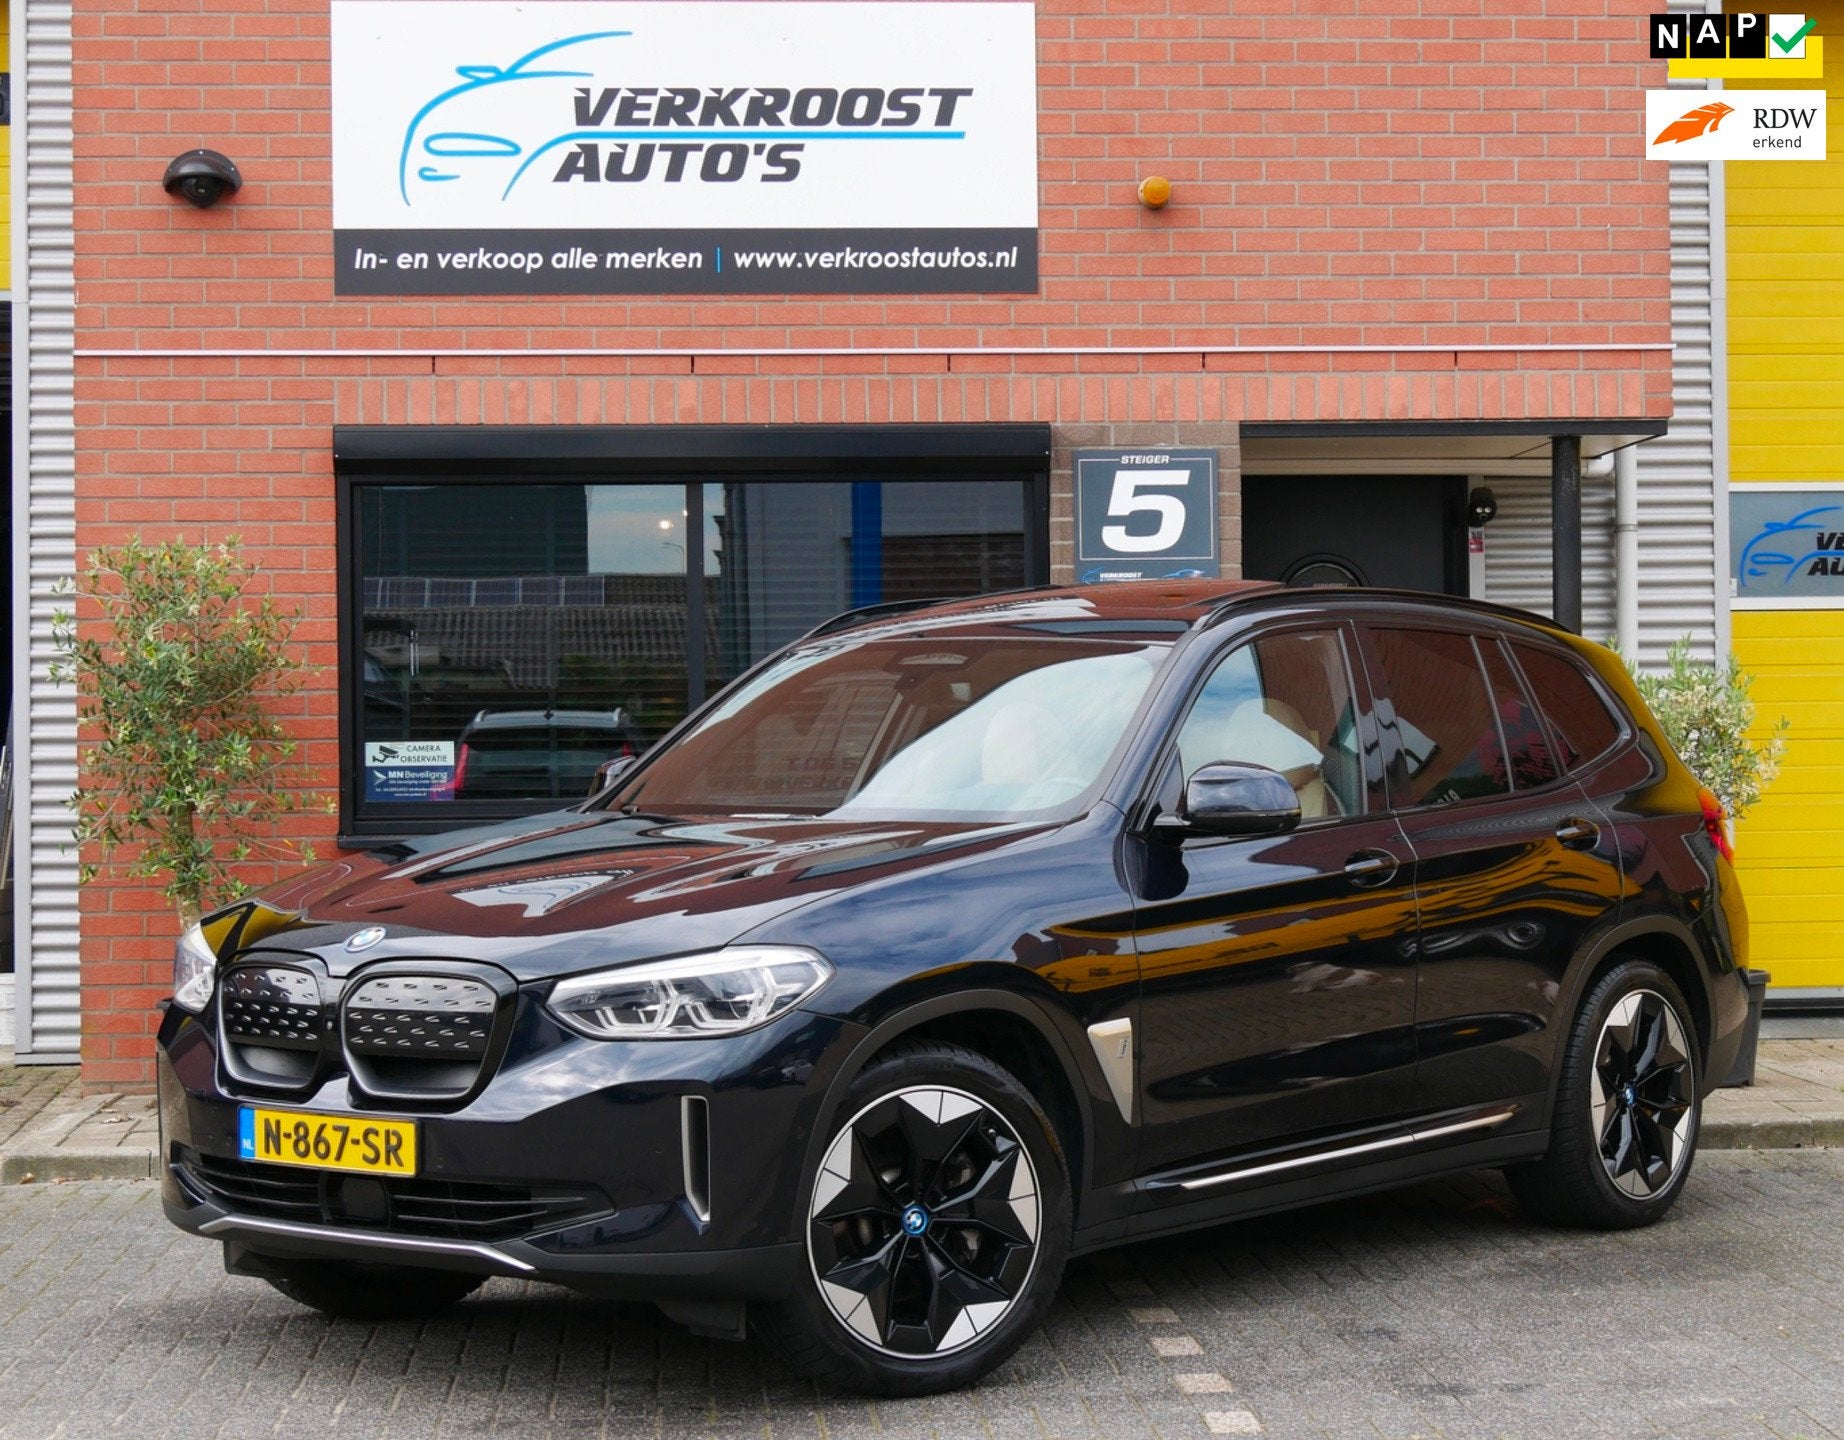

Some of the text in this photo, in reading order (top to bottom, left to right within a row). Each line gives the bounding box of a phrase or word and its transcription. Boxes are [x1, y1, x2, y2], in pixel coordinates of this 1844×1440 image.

[574, 88, 973, 127] VERKROOST
[552, 143, 804, 183] AUTO'S
[354, 246, 1018, 273] In- en verkoop alle merken www.verkroostautos.nl
[1121, 455, 1170, 464] STEIGER
[1101, 470, 1191, 552] 5
[400, 754, 448, 763] OBSERVATIE
[406, 744, 441, 753] CAMERA
[243, 1138, 254, 1151] NL
[263, 1116, 405, 1168] N-867-SR
